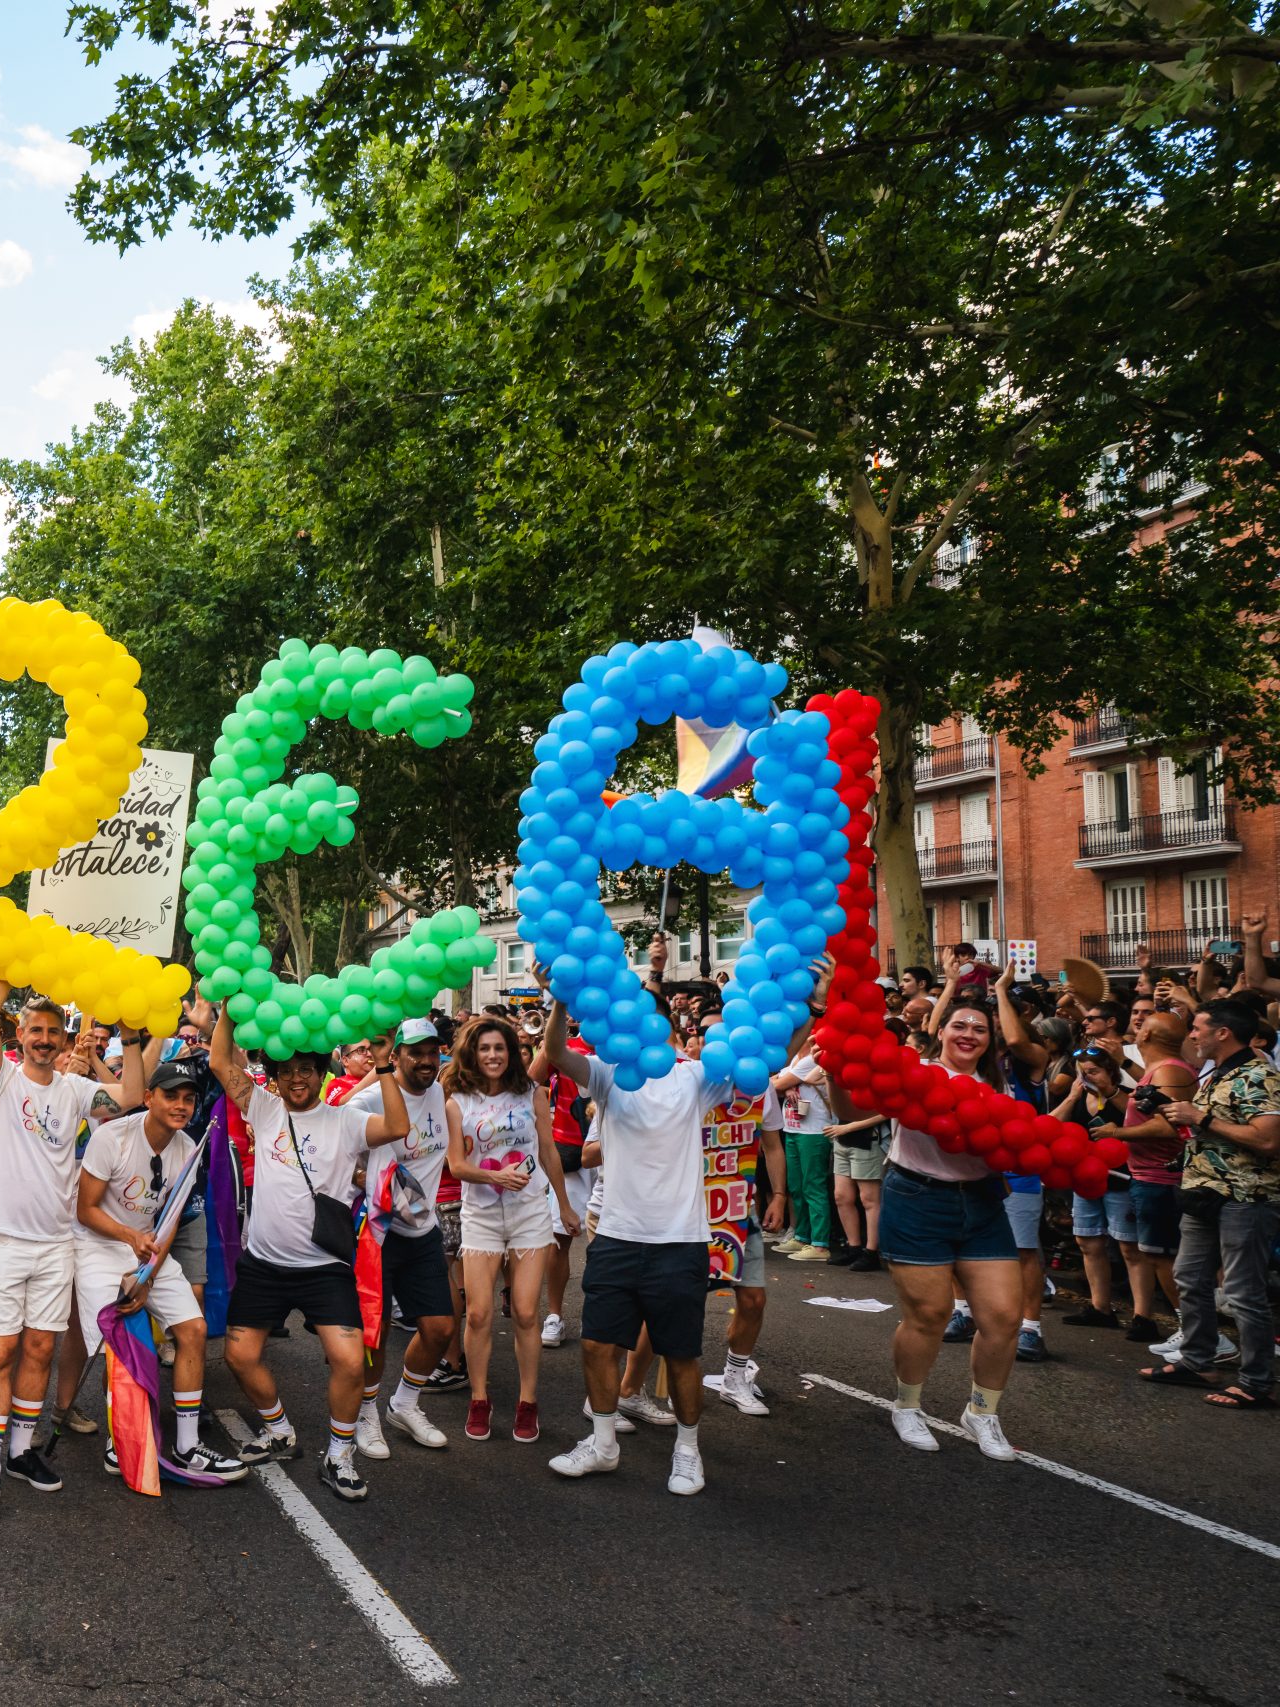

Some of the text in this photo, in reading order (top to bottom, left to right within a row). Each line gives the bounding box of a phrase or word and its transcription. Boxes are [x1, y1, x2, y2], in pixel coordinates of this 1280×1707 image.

[118, 791, 182, 819] sidad
[41, 838, 170, 886] ortalece,
[404, 1112, 435, 1151] Out
[475, 1111, 516, 1142] Out
[702, 1122, 756, 1148] FIGHT
